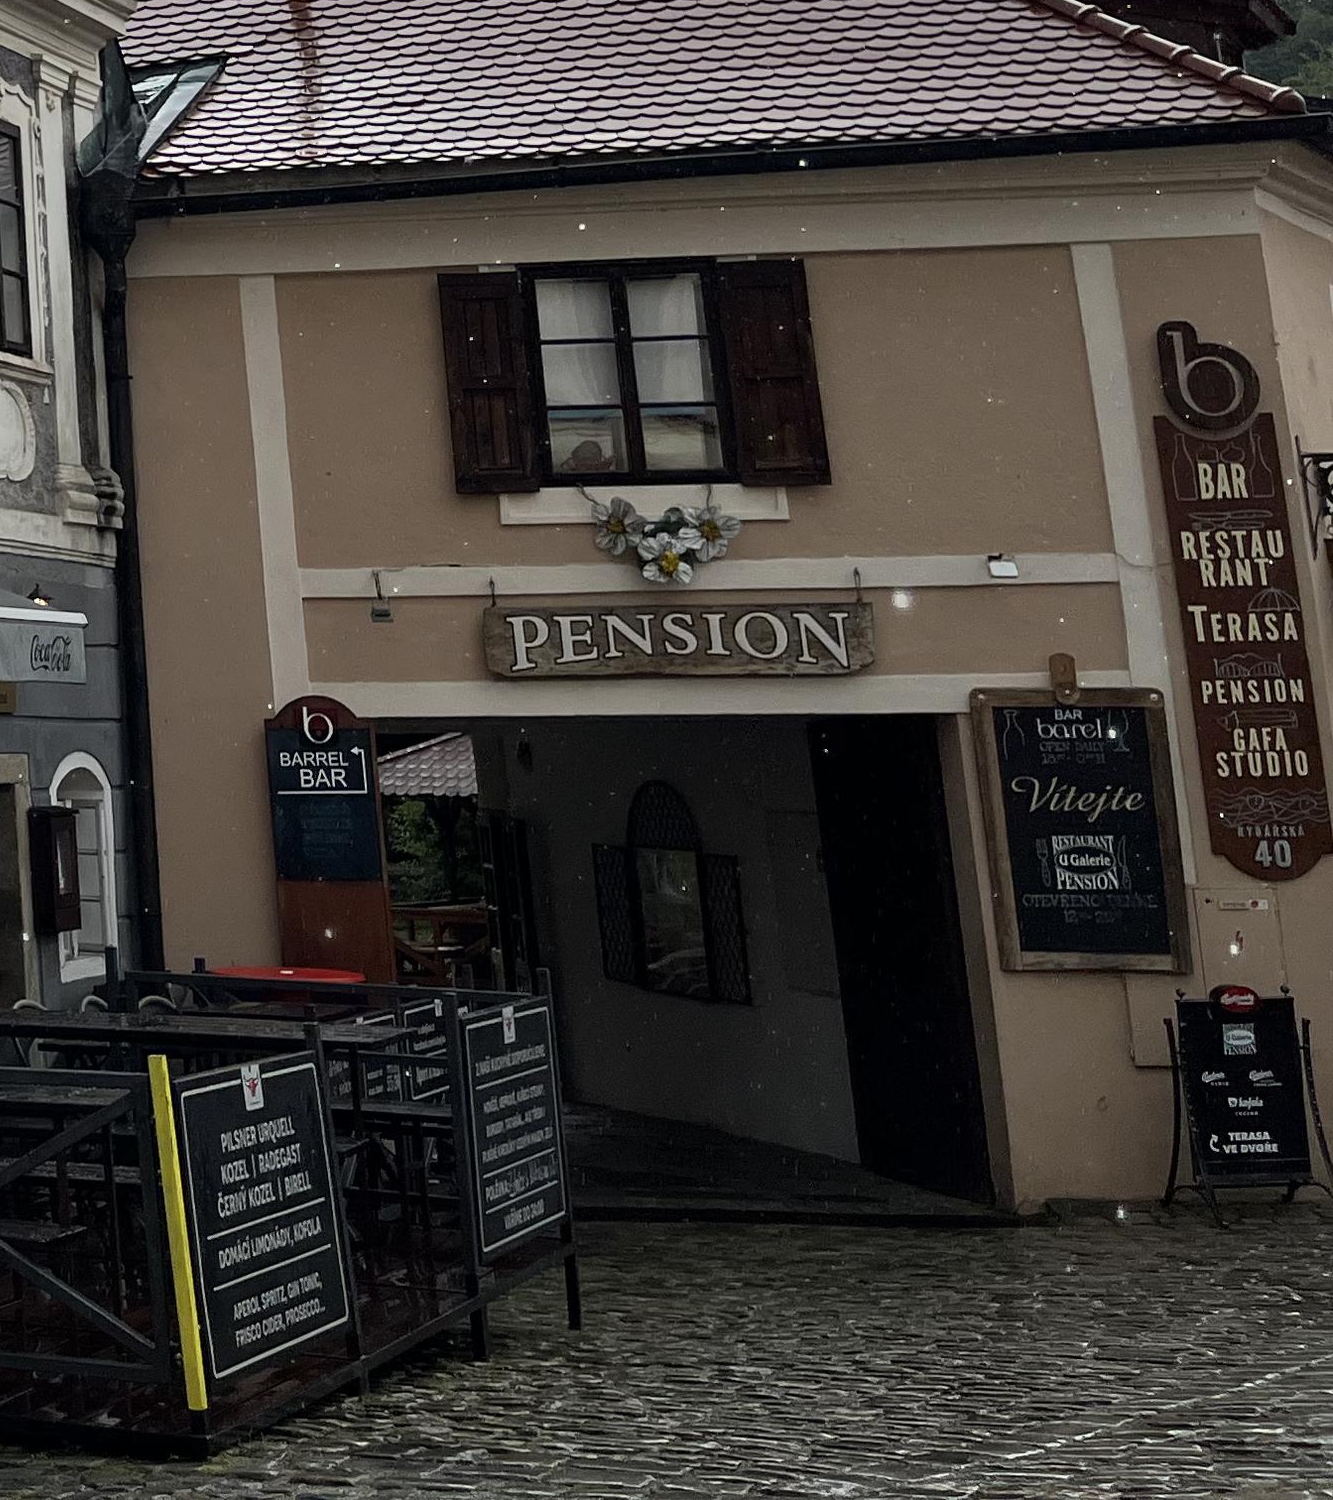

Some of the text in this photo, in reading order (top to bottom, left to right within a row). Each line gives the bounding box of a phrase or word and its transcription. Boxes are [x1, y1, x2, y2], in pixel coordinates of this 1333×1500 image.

[1198, 463, 1249, 500] BAR
[1181, 530, 1284, 560] RESTAU
[1199, 557, 1270, 587] RANT
[1187, 605, 1299, 642] TERASA
[505, 609, 851, 672] PENSION
[1201, 678, 1305, 705] PENSION
[1054, 708, 1083, 720] BAR
[1233, 727, 1288, 751] GAFA
[279, 751, 349, 767] BARREL
[1216, 750, 1309, 778] STUDIO
[300, 769, 347, 788] BAR
[1011, 776, 1145, 823] Vítejte
[1051, 835, 1114, 854] RESTAURANT
[1255, 839, 1293, 868] 40
[1059, 853, 1111, 866] U Galerie
[1056, 867, 1119, 890] PENSION
[221, 1115, 296, 1154] PILSNER URQUELL
[1223, 1141, 1279, 1154] VE DVOŘE
[1228, 1131, 1270, 1141] TERASA
[220, 1143, 301, 1186] KOZEL RADEGAST
[217, 1184, 247, 1218] ČERNÝ
[248, 1182, 276, 1208] KOZEL
[218, 1234, 251, 1269] DOMÁCÍ
[293, 1215, 323, 1243] KOFOLA
